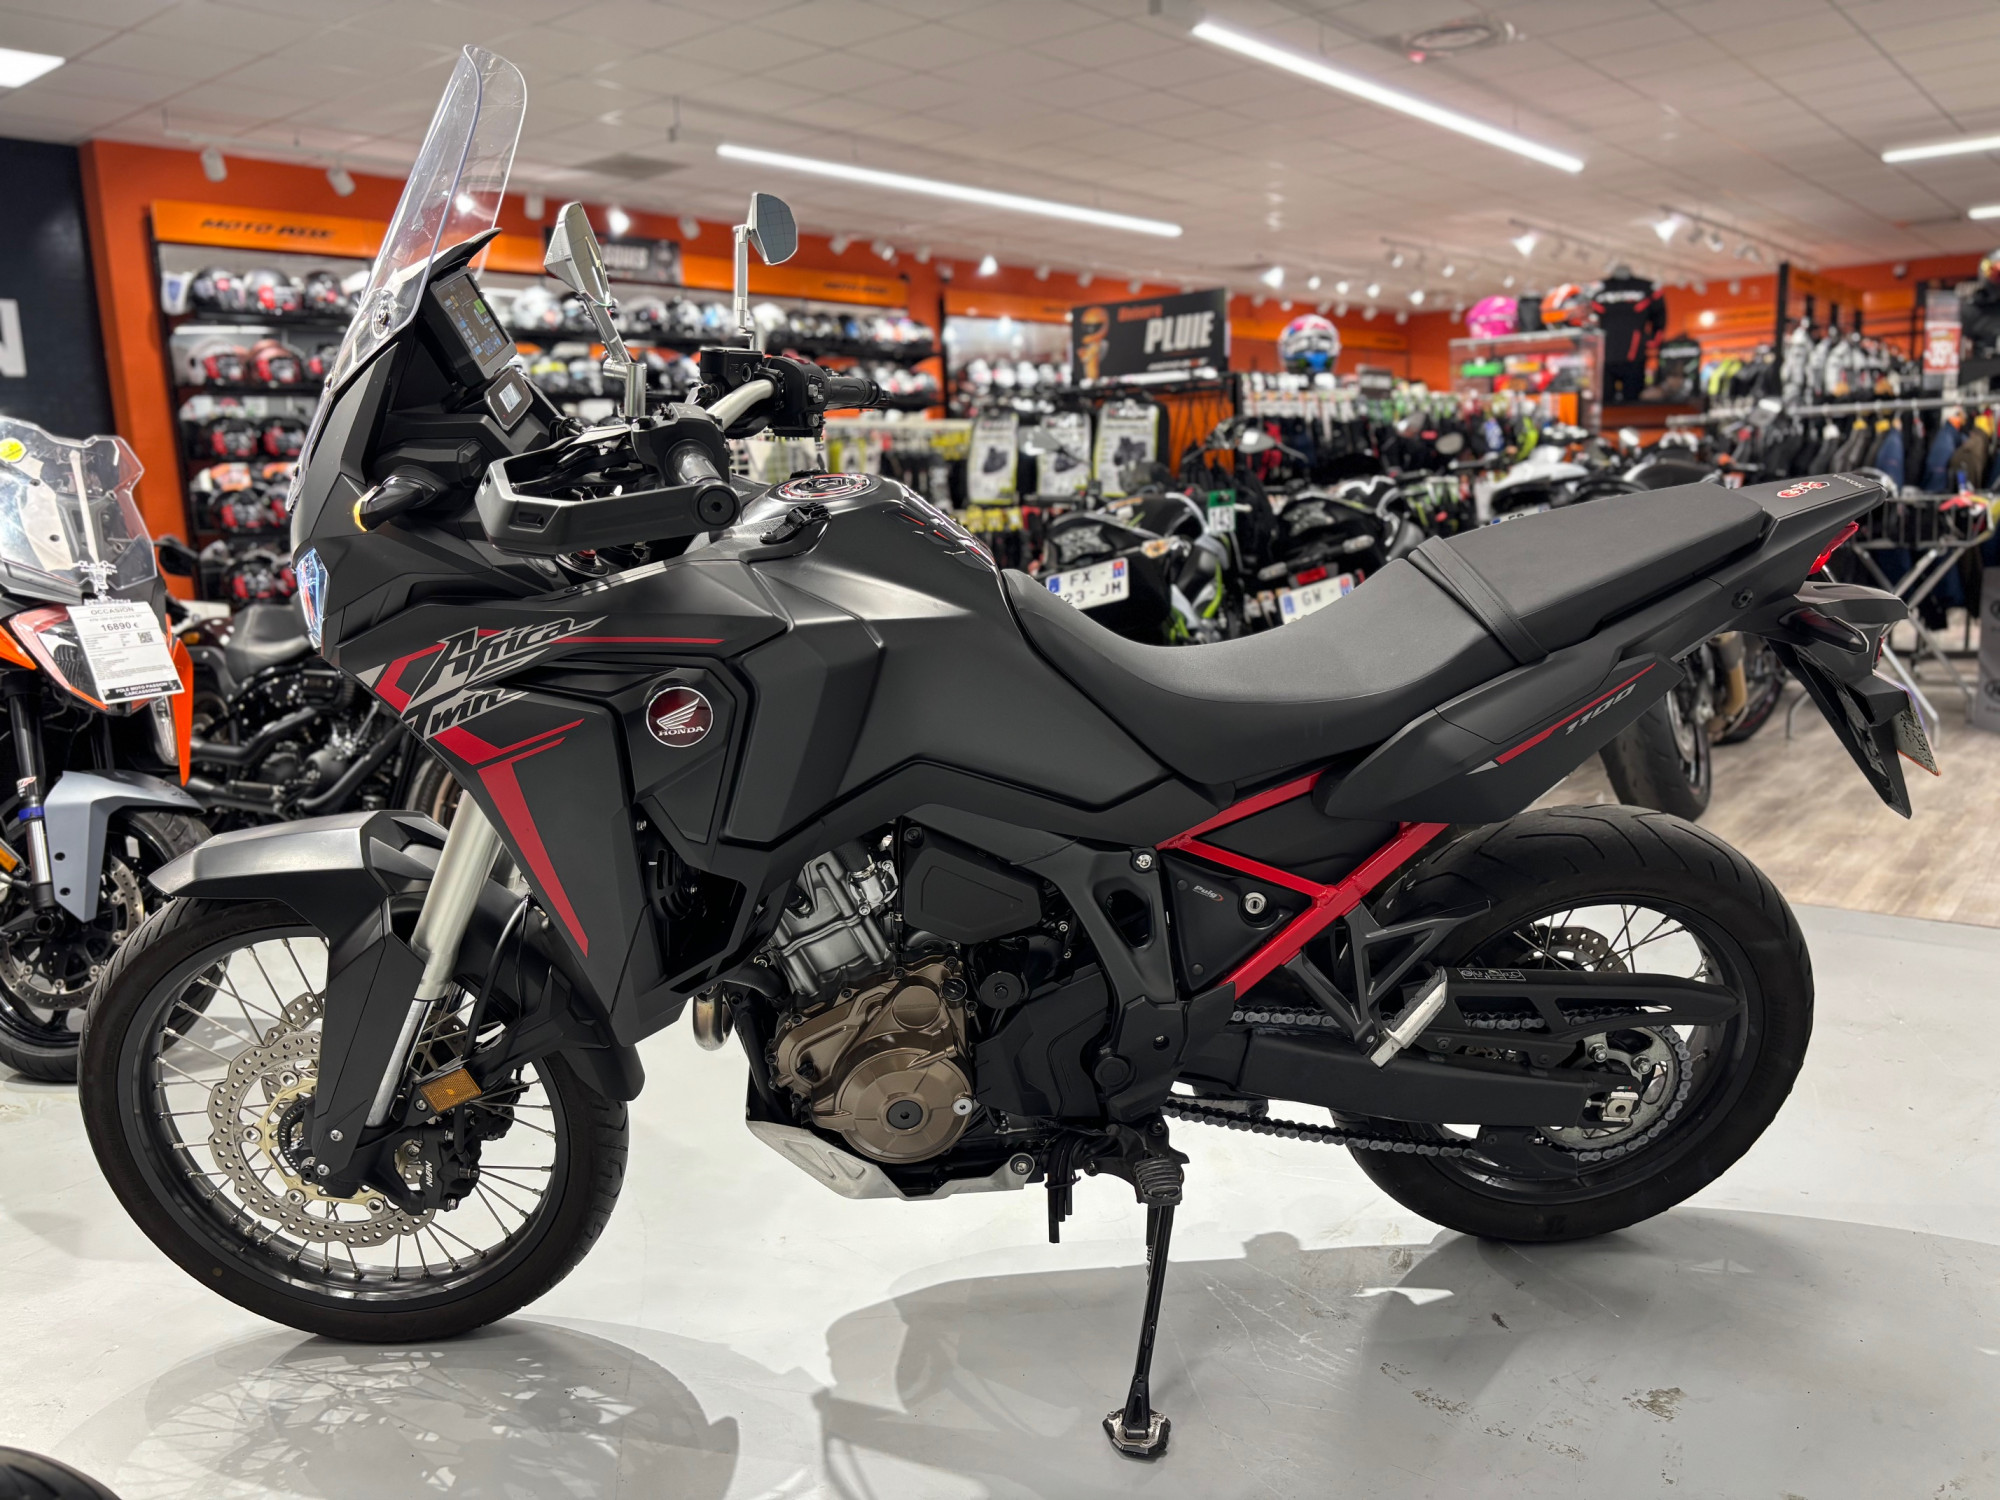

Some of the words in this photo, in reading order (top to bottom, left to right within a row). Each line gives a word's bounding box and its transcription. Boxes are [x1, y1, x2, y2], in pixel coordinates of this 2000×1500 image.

[1144, 311, 1215, 353] PLUIE
[91, 607, 134, 615] OCCASION
[101, 622, 131, 631] 16890
[407, 615, 608, 703] Africa
[401, 686, 530, 739] Twin
[1565, 683, 1637, 735] 1100
[658, 725, 705, 737] HONDA
[1192, 885, 1218, 899] Puig
